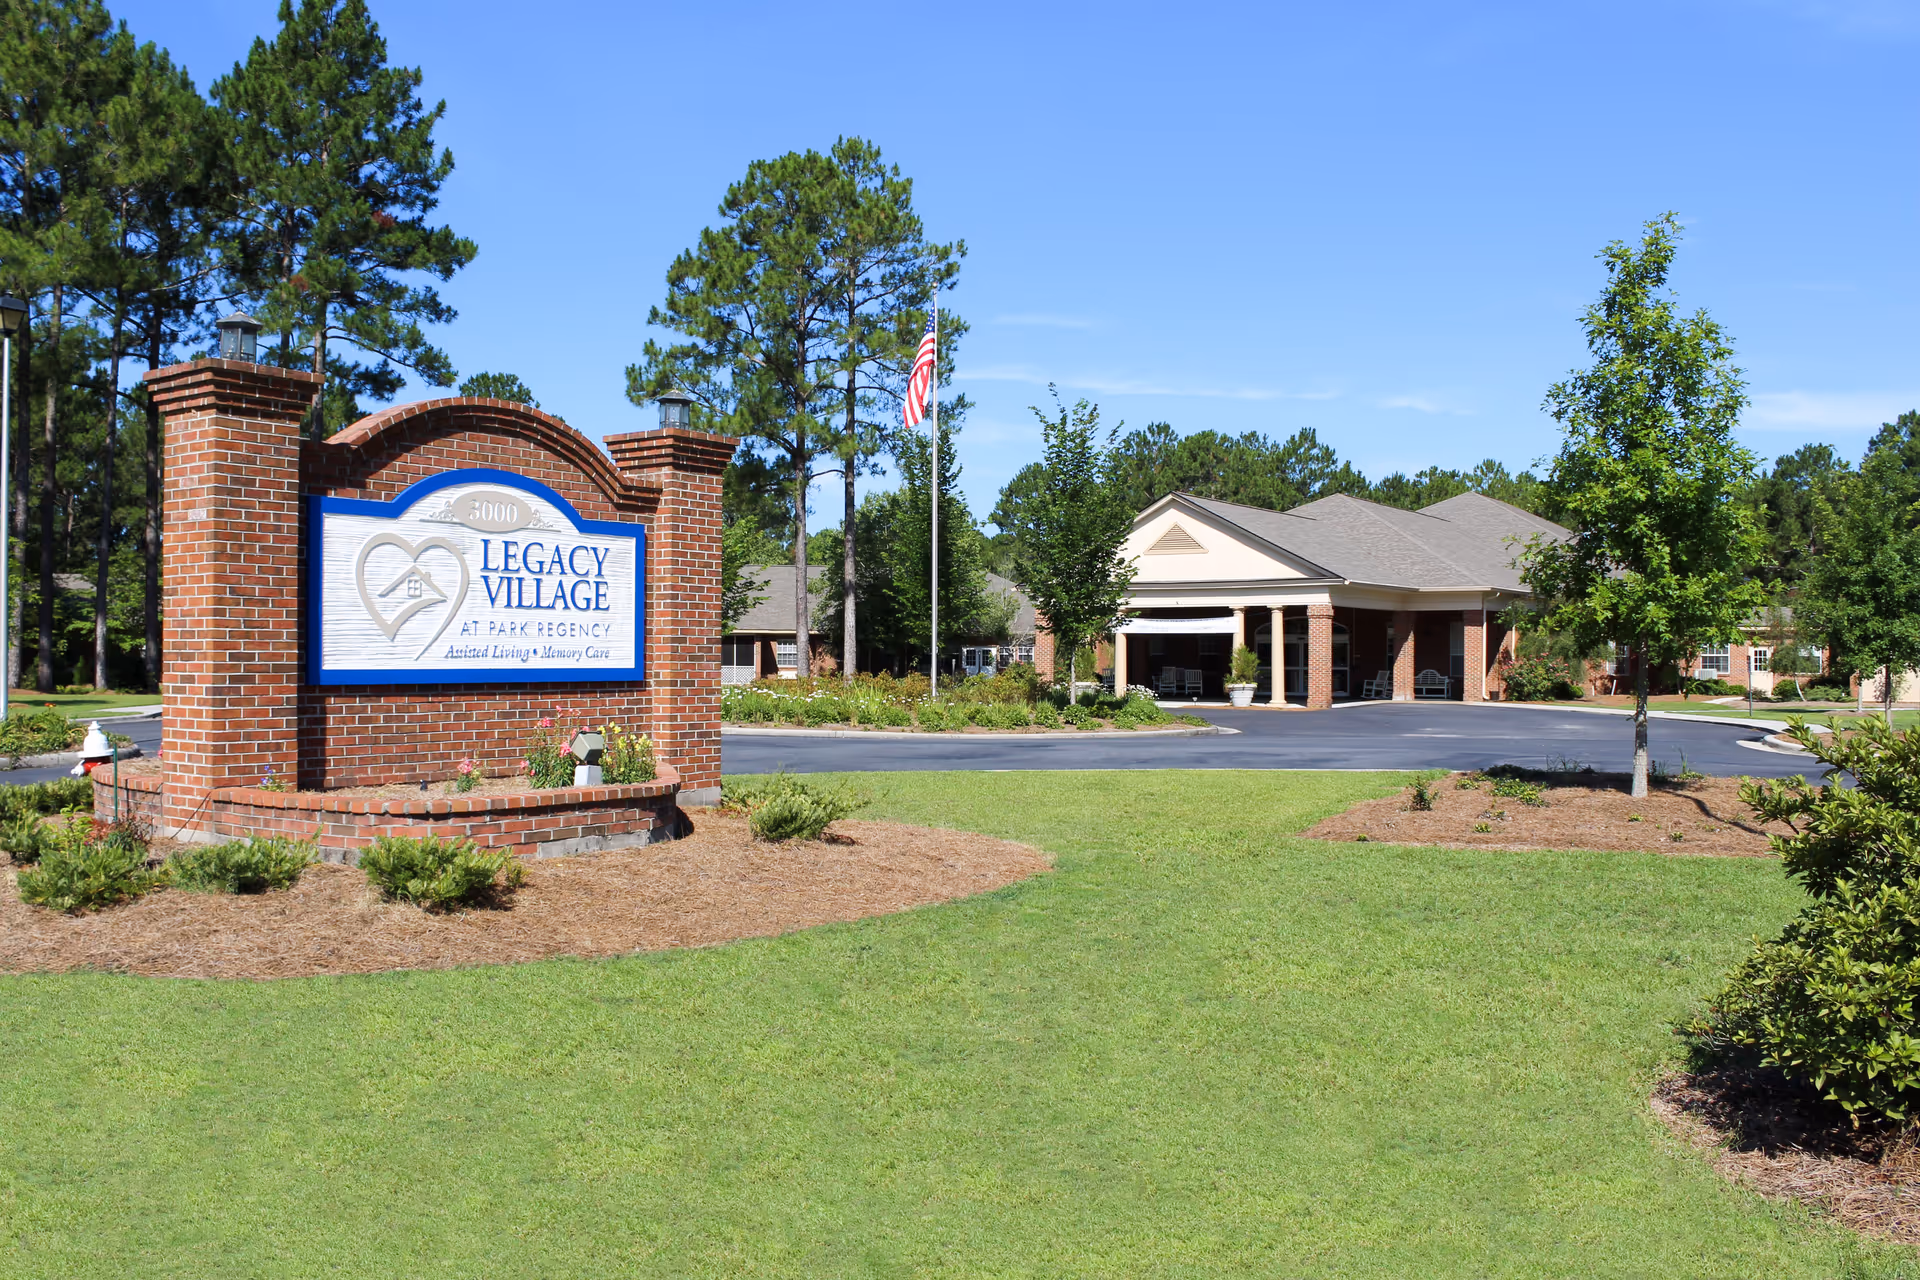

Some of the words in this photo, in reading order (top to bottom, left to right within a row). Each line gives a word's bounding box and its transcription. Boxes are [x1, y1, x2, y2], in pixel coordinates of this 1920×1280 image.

[468, 499, 518, 523] 3000
[480, 539, 610, 578] LEGACY
[480, 575, 611, 611] VILLAGE
[460, 620, 479, 636] AT
[489, 621, 528, 637] PARK
[537, 622, 611, 638] REGENCY
[444, 645, 489, 659] Assisted
[491, 645, 530, 663] Living
[540, 645, 583, 662] Memory
[585, 646, 610, 659] Care
